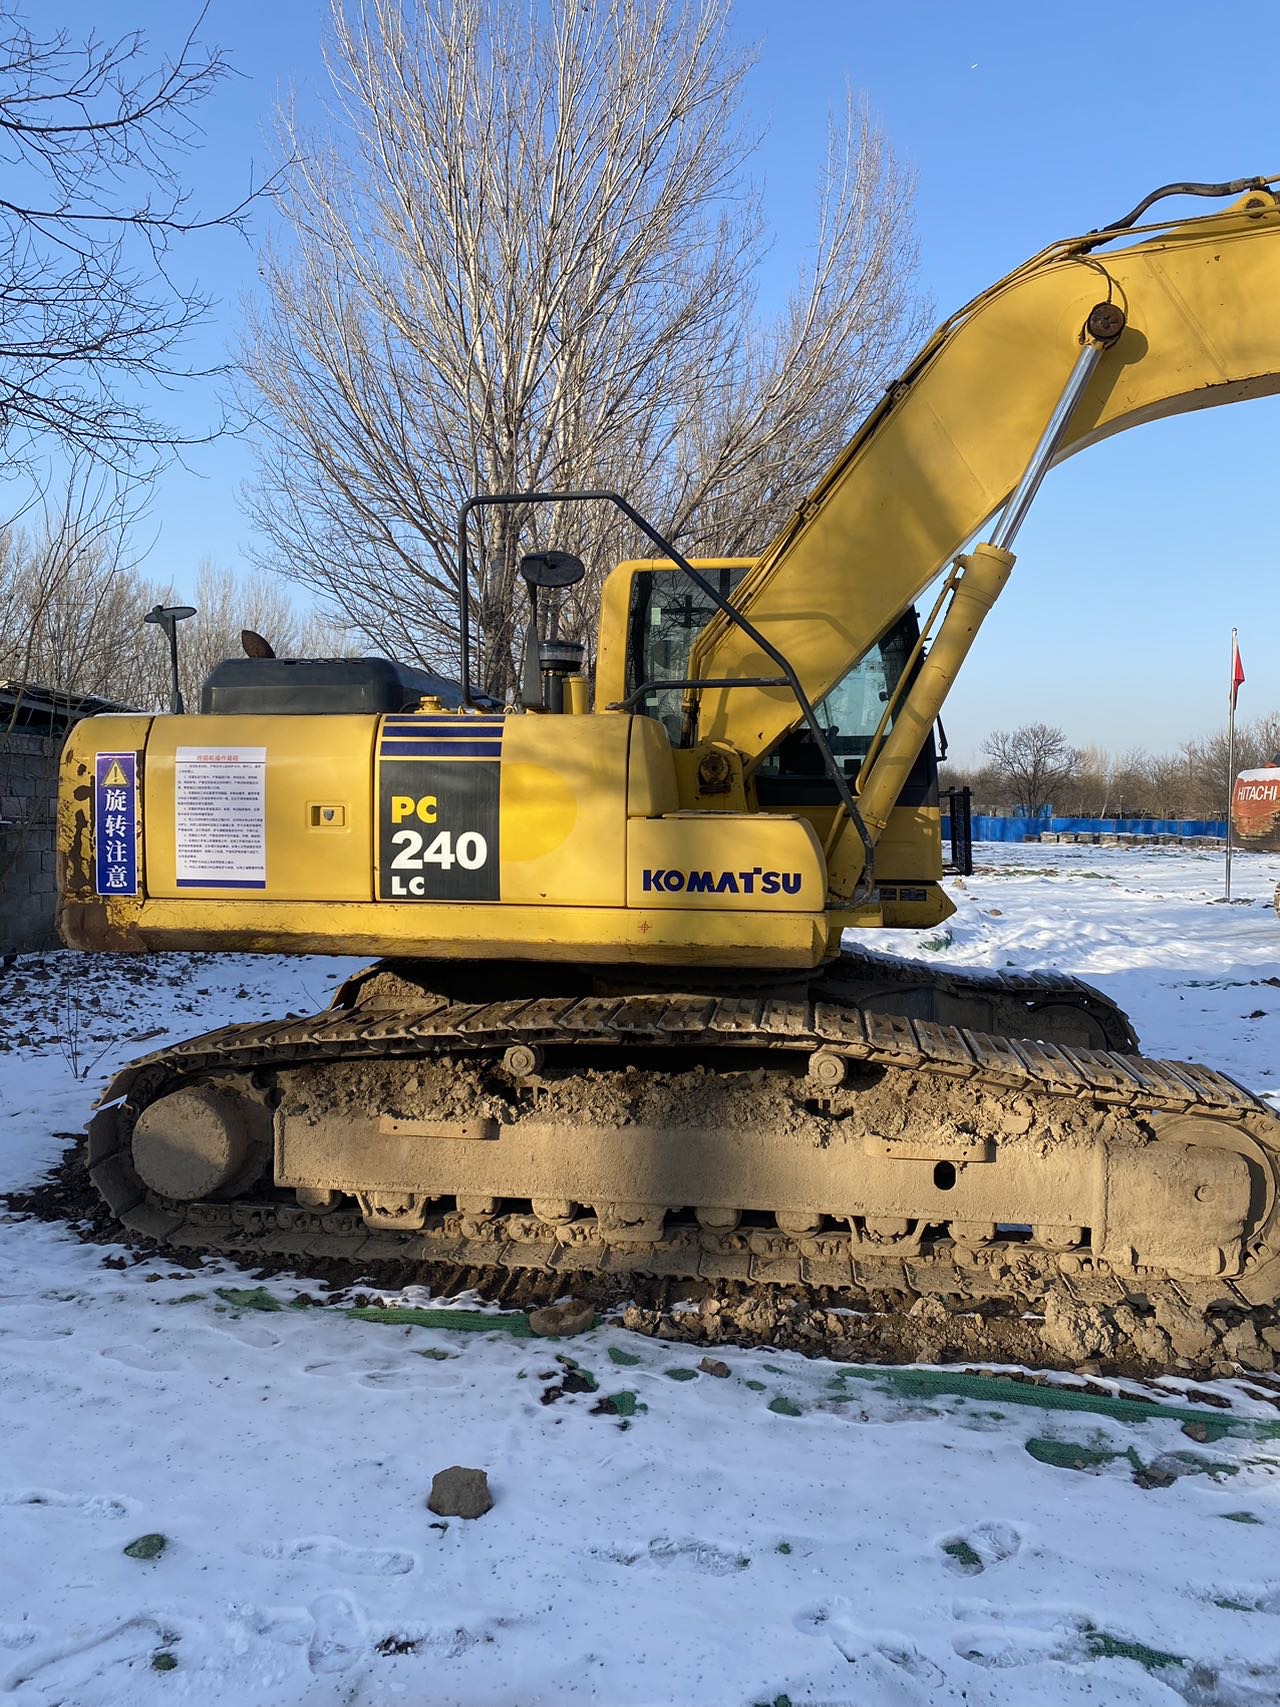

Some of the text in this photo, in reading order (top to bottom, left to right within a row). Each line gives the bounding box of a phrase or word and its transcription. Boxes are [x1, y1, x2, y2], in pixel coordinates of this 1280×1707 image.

[1237, 785, 1278, 801] HITACHI
[391, 795, 437, 824] PC
[105, 789, 128, 888] 旋转注意
[390, 829, 488, 870] 240
[391, 876, 425, 895] LC
[642, 867, 802, 894] KOMATSU
